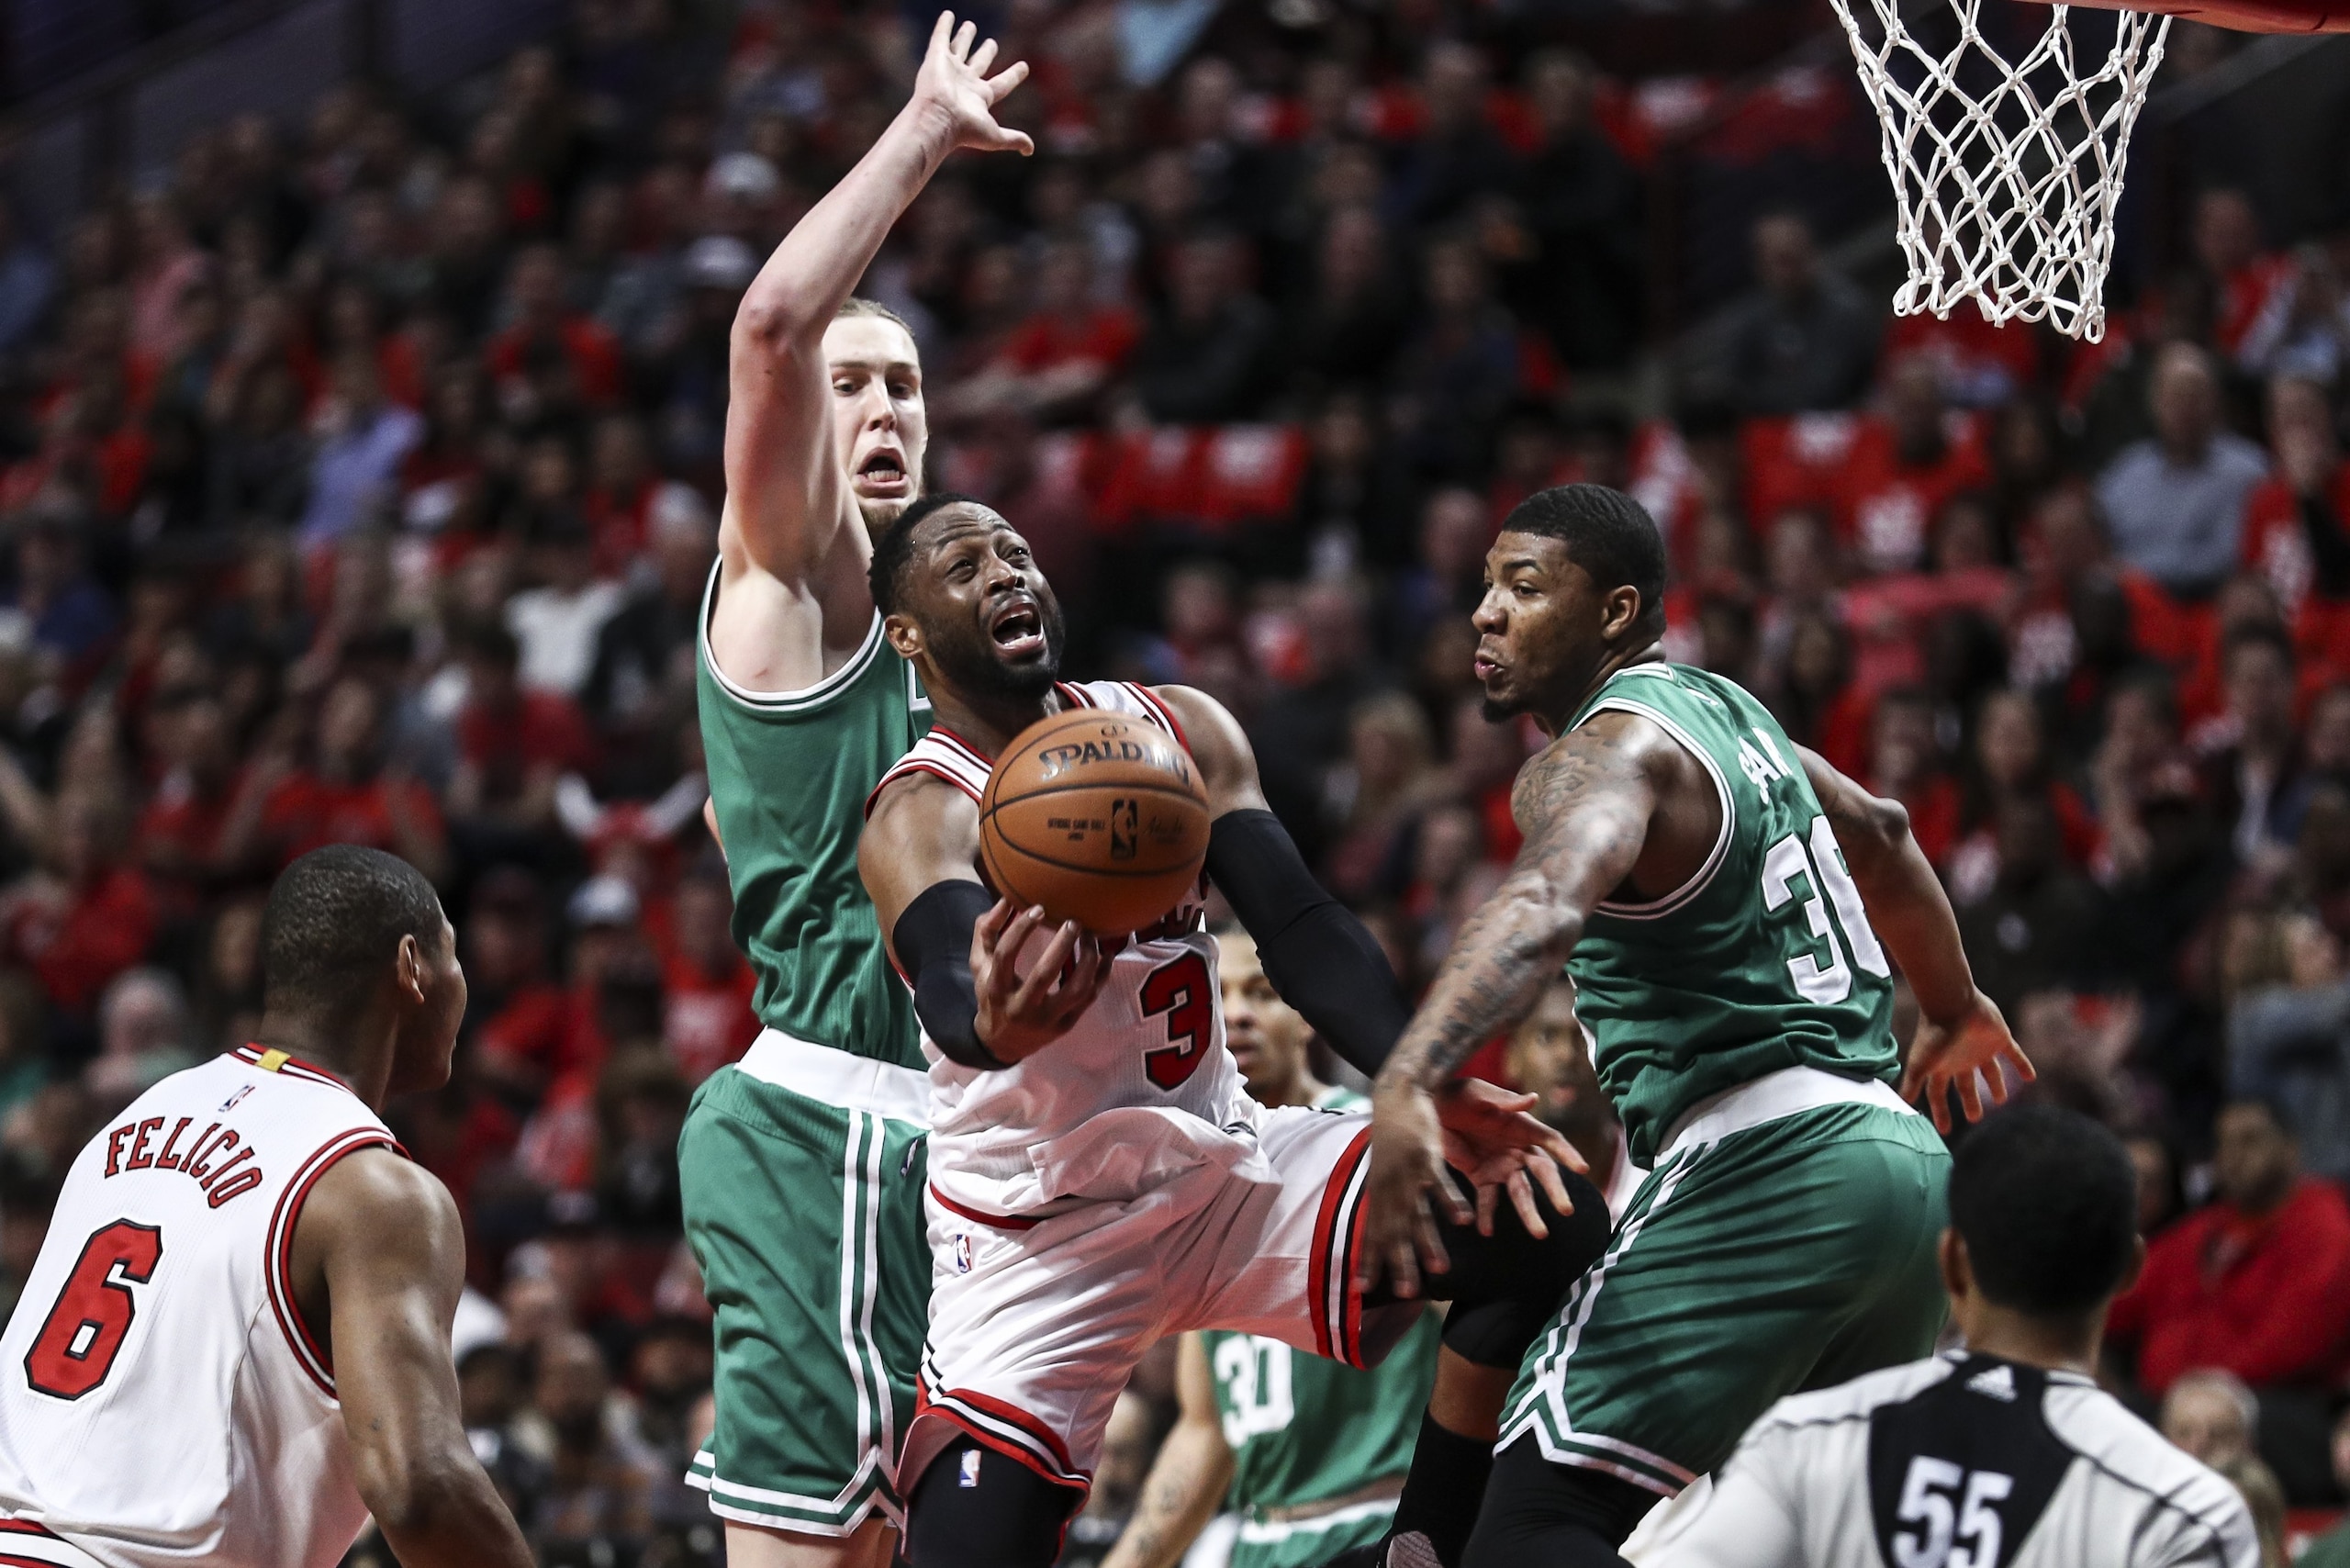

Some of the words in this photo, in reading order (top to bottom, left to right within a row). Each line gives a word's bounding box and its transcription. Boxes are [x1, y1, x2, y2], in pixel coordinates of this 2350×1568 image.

[1038, 740, 1190, 788] SPALDING
[1139, 948, 1214, 1092] 3
[105, 1116, 263, 1209] FELICIO
[24, 1217, 162, 1401] 6
[1214, 1334, 1294, 1448] 30
[1891, 1454, 2015, 1568] 55
